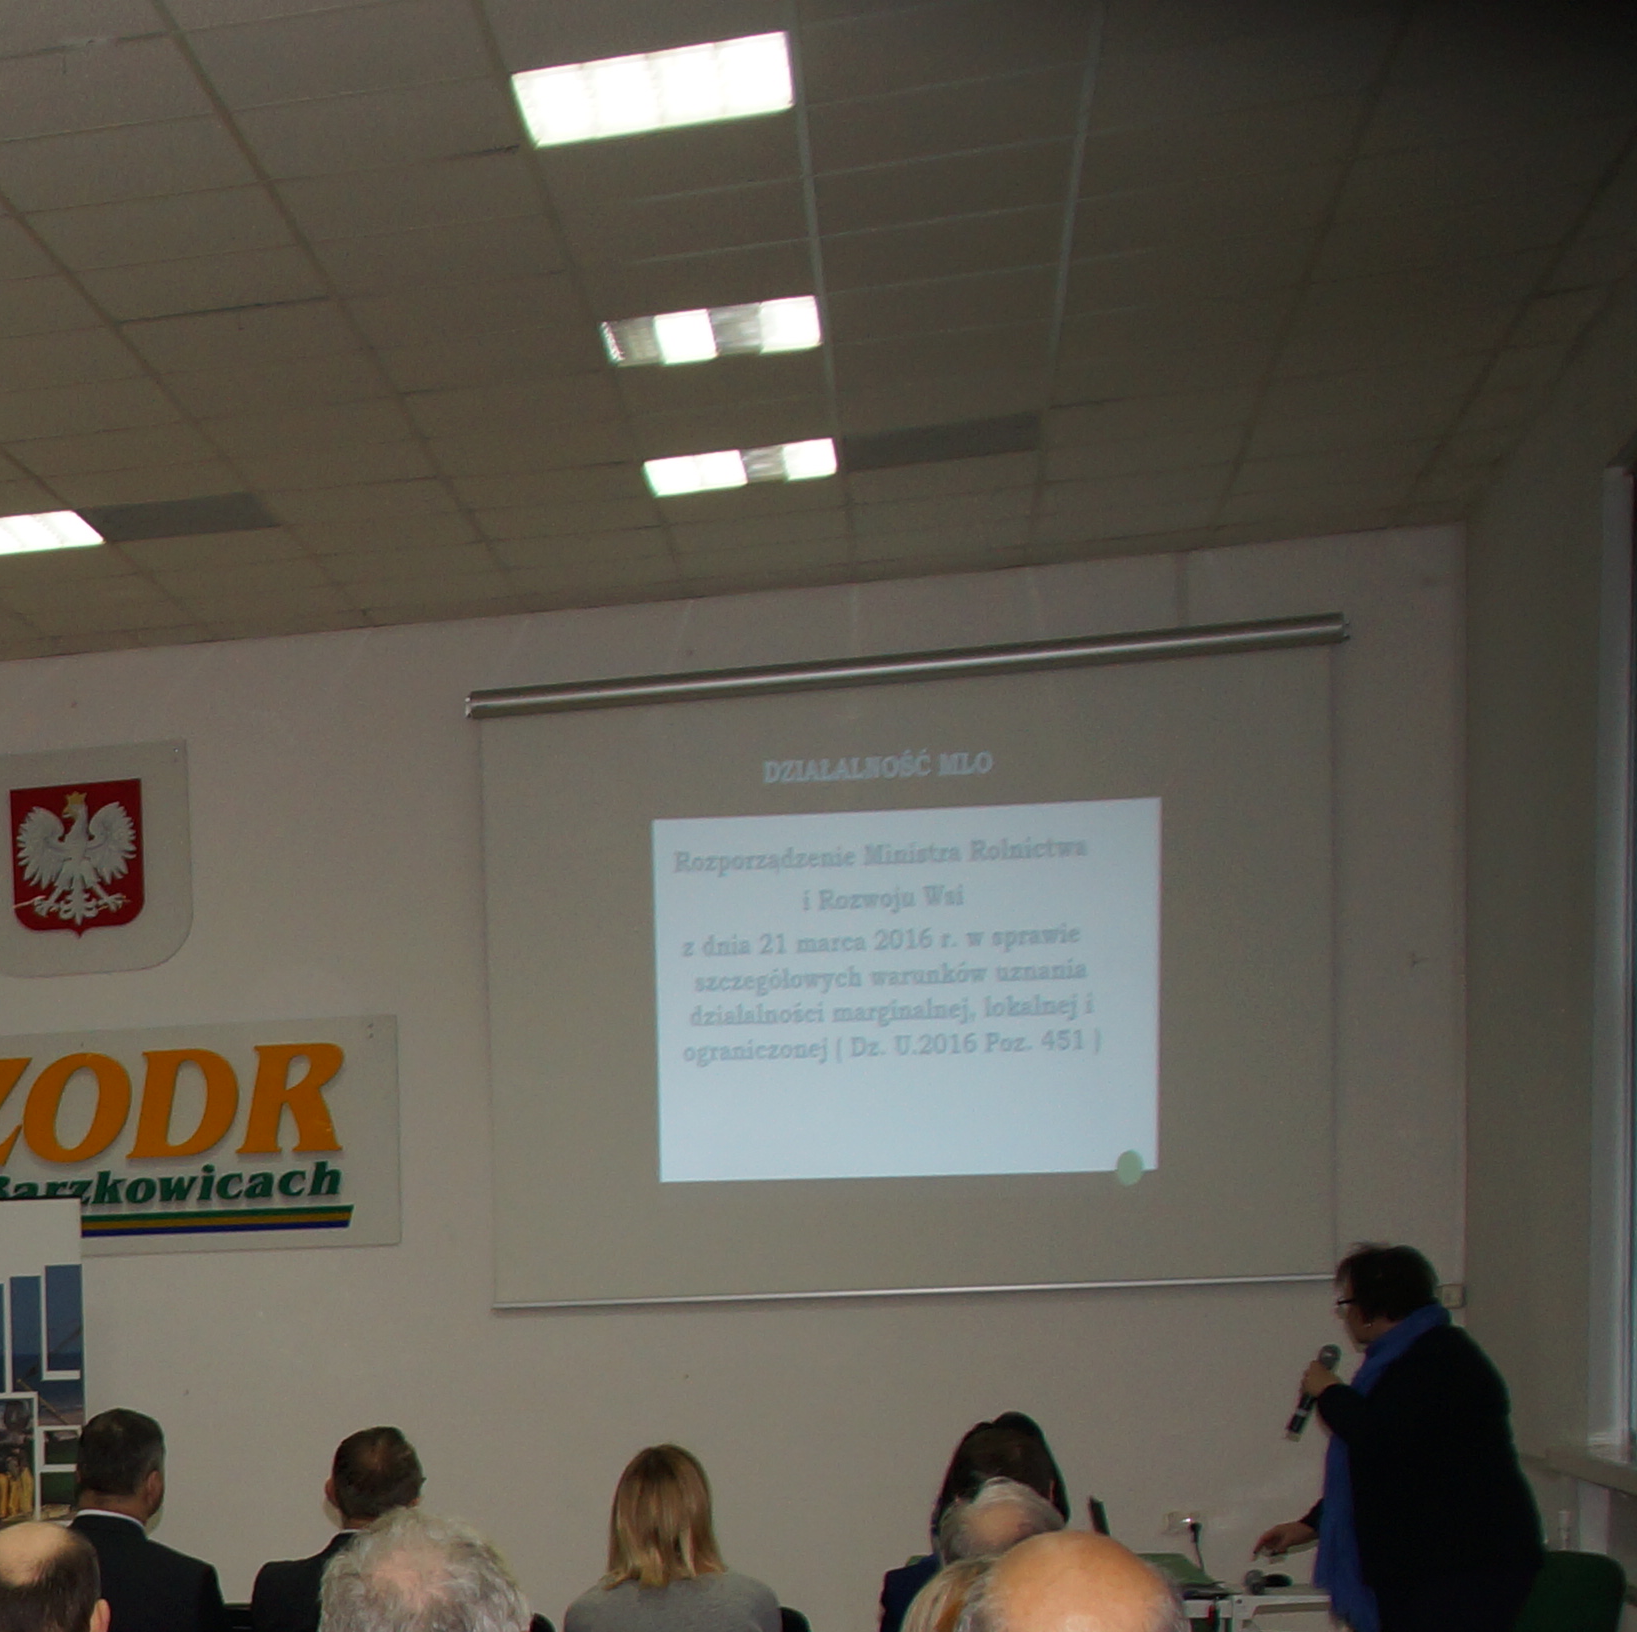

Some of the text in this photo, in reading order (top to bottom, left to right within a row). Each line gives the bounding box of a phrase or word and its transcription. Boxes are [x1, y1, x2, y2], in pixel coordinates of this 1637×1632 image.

[673, 836, 1087, 877] Rozporządzenie Ministra Rolnictwa
[803, 884, 964, 914] i Rozwoju Wsi
[681, 923, 1081, 957] z dnia 21 marca 2016 r. w sprawie
[694, 958, 1087, 996] szczegółowych warunków uznania
[832, 998, 975, 1027] marginalnej,
[984, 994, 1077, 1021] lokalnej
[1085, 992, 1095, 1015] i
[683, 1037, 828, 1065] ograniczonej
[850, 1034, 885, 1057] Dz.
[984, 1031, 1032, 1054] Poz.
[1041, 1028, 1084, 1051] 451
